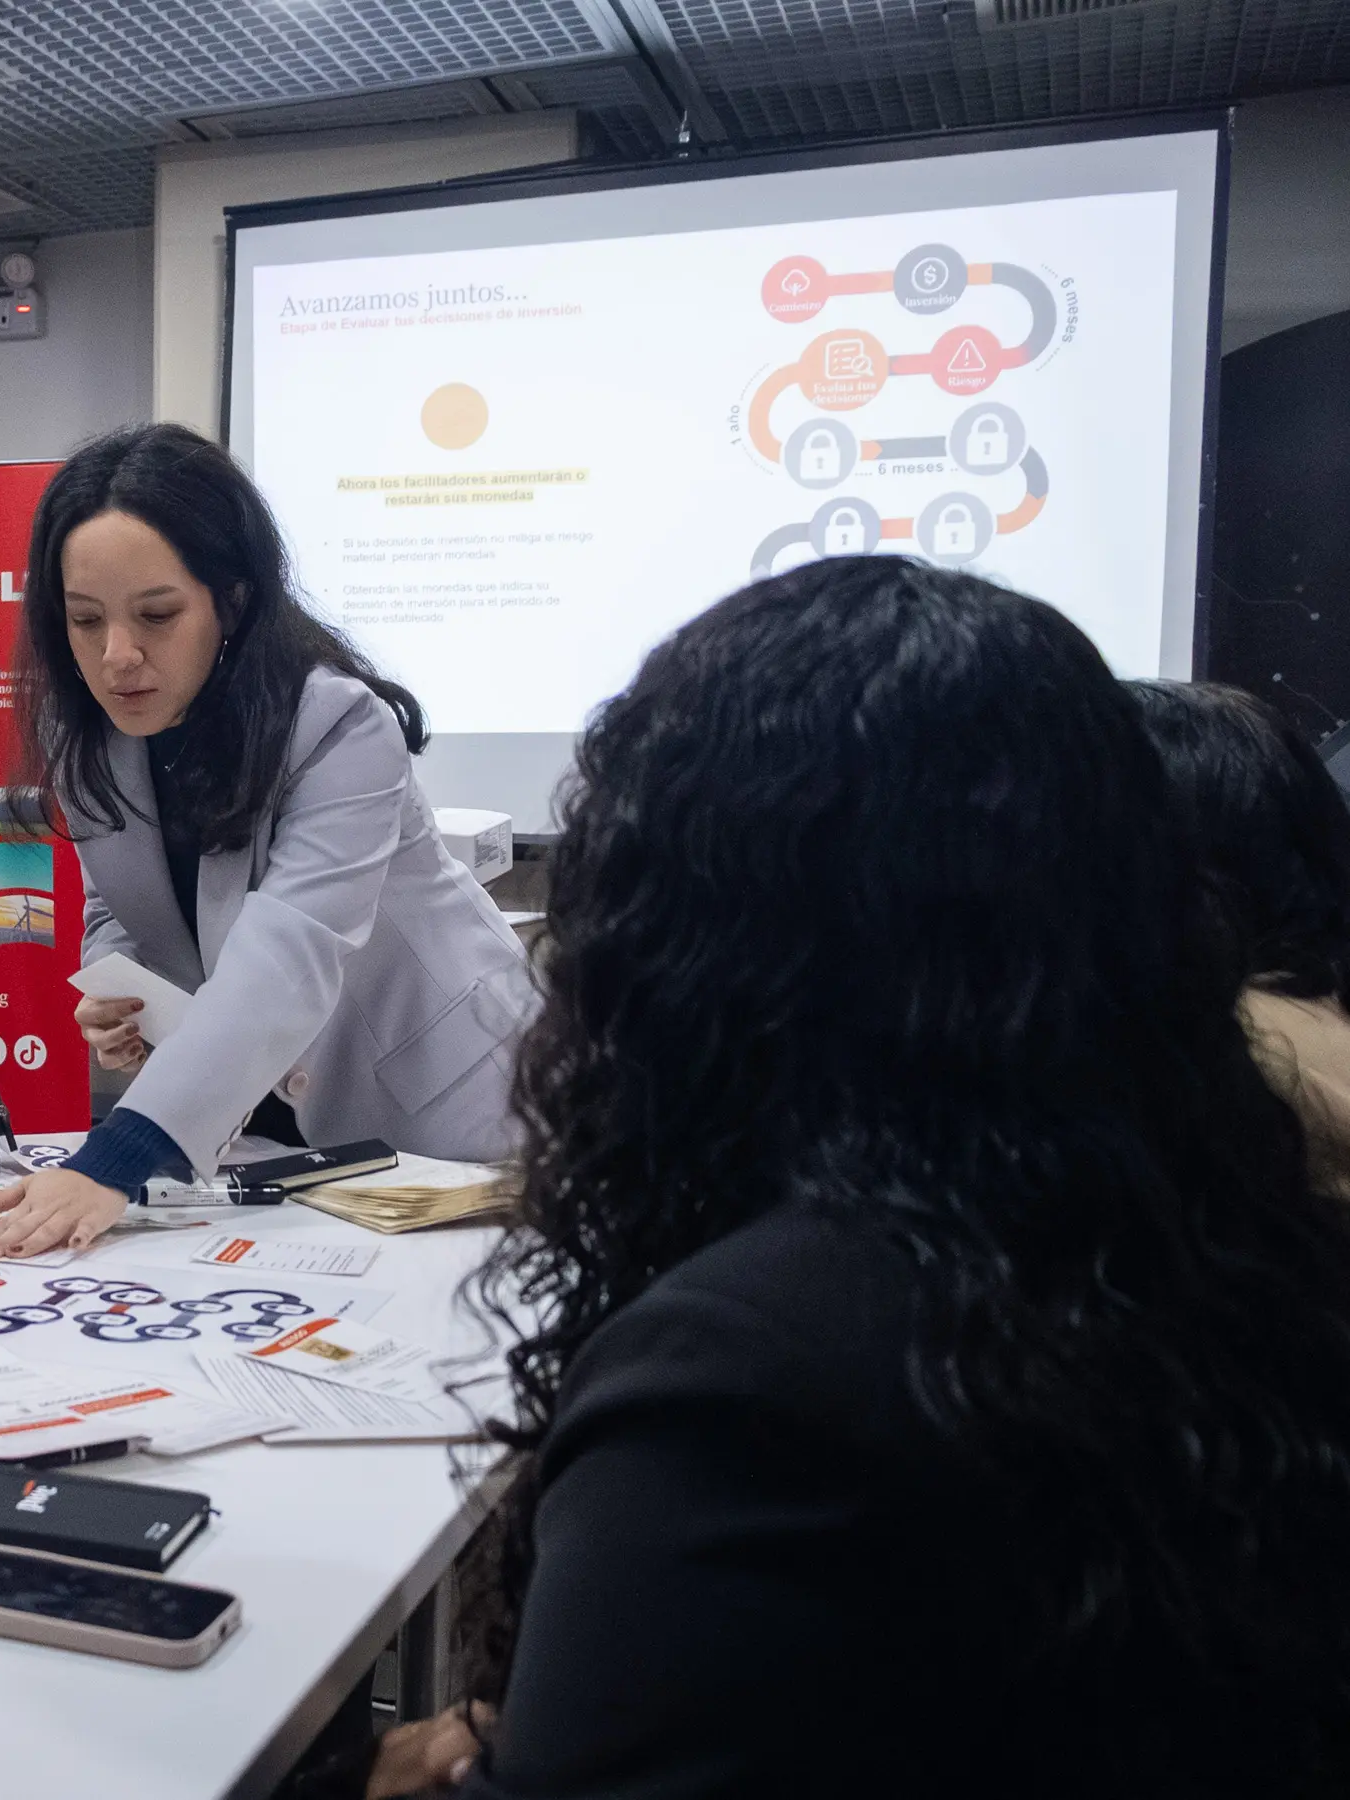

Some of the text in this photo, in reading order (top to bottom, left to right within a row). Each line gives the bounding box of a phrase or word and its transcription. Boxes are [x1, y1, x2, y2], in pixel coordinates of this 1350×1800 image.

[280, 283, 528, 317] Avanzamos juntos...
[1060, 277, 1078, 343] 6 meses
[280, 322, 317, 336] Etapa
[321, 320, 337, 331] de
[341, 316, 390, 330] Evaluar
[394, 315, 414, 326] tus
[419, 311, 492, 325] decisiones
[496, 307, 513, 320] de
[727, 404, 740, 432] año
[337, 478, 376, 490] Ahora
[380, 477, 400, 488] los
[404, 474, 487, 488] facilitadores
[576, 472, 585, 481] o
[878, 462, 944, 475] 6 meses
[444, 494, 467, 504] sus
[471, 490, 534, 503] monedas
